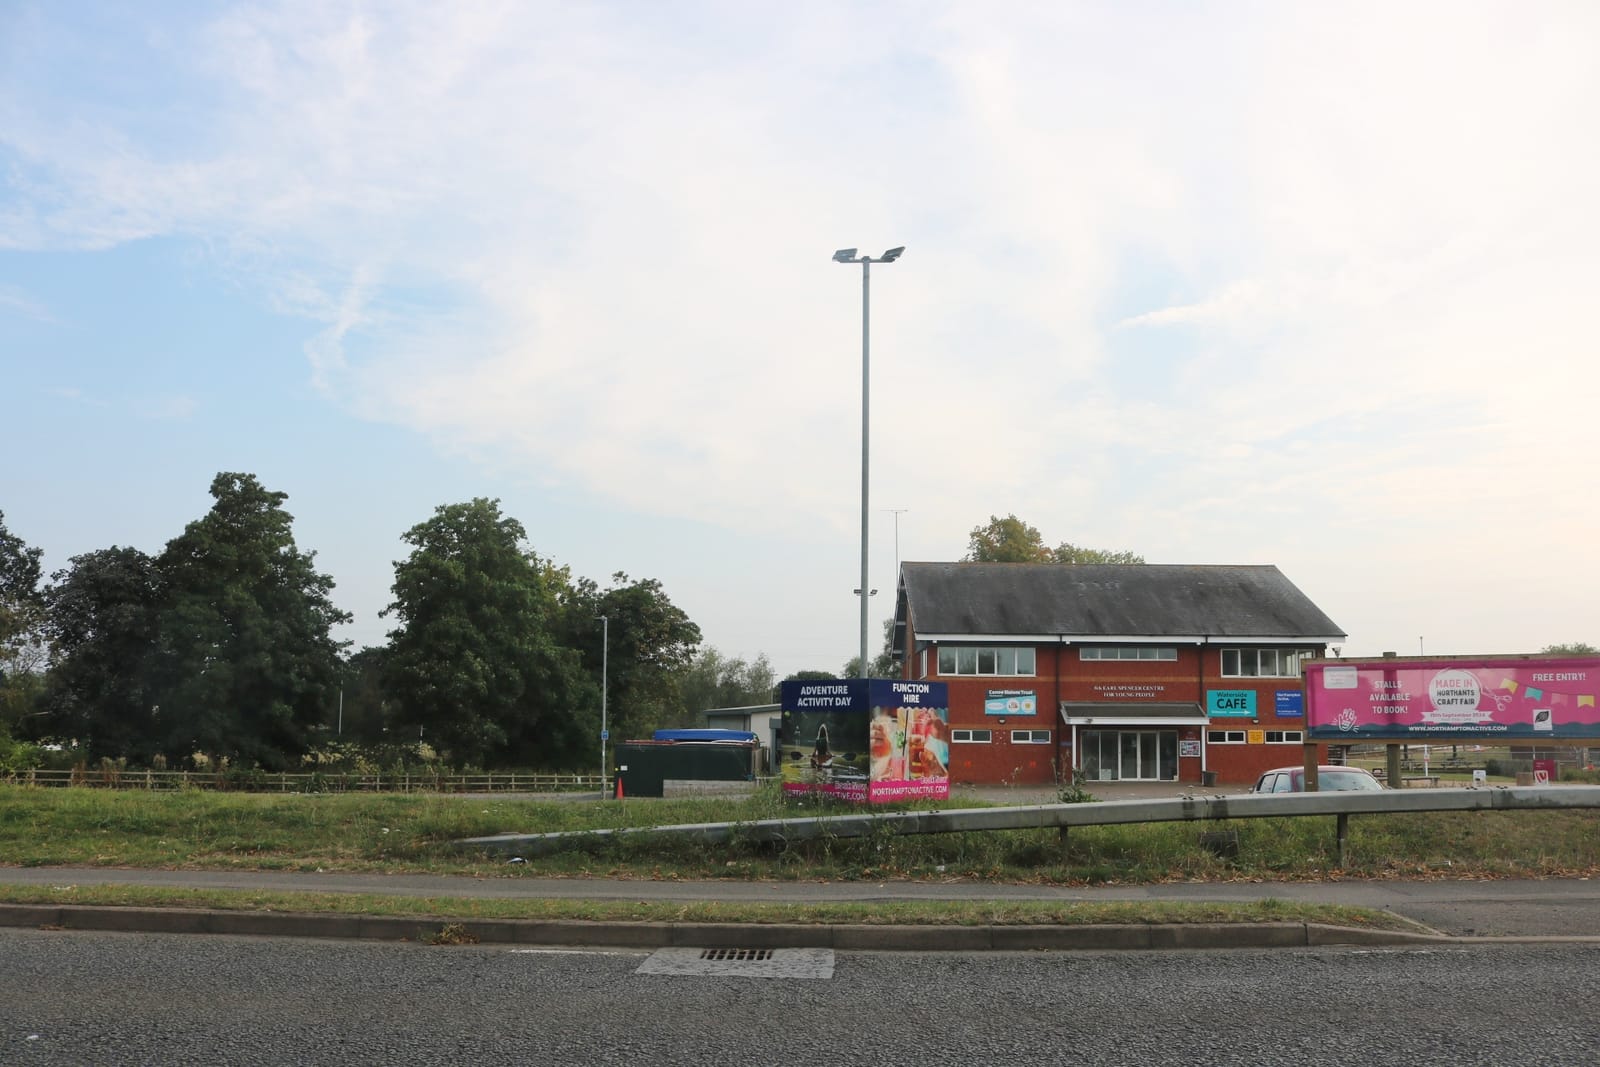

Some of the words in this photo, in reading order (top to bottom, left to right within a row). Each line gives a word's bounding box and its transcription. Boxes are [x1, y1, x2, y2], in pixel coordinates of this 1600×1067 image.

[1533, 673, 1554, 681] FREE
[1556, 672, 1586, 681] ENTRY!
[892, 683, 930, 693] FUNCTION
[1374, 681, 1402, 689] STALLS
[1435, 680, 1460, 688] MADE
[1463, 680, 1473, 688] IN
[800, 685, 848, 695] ADVENTURE
[903, 694, 920, 703] HIRE
[1369, 693, 1410, 701] AVAILABLE
[797, 697, 834, 707] ACTIVITY
[835, 697, 852, 706] DAY
[1216, 698, 1247, 709] CAFE
[1384, 705, 1408, 714] BOOK!
[872, 785, 948, 796] NORTHAMPTONACTIVE.COM
